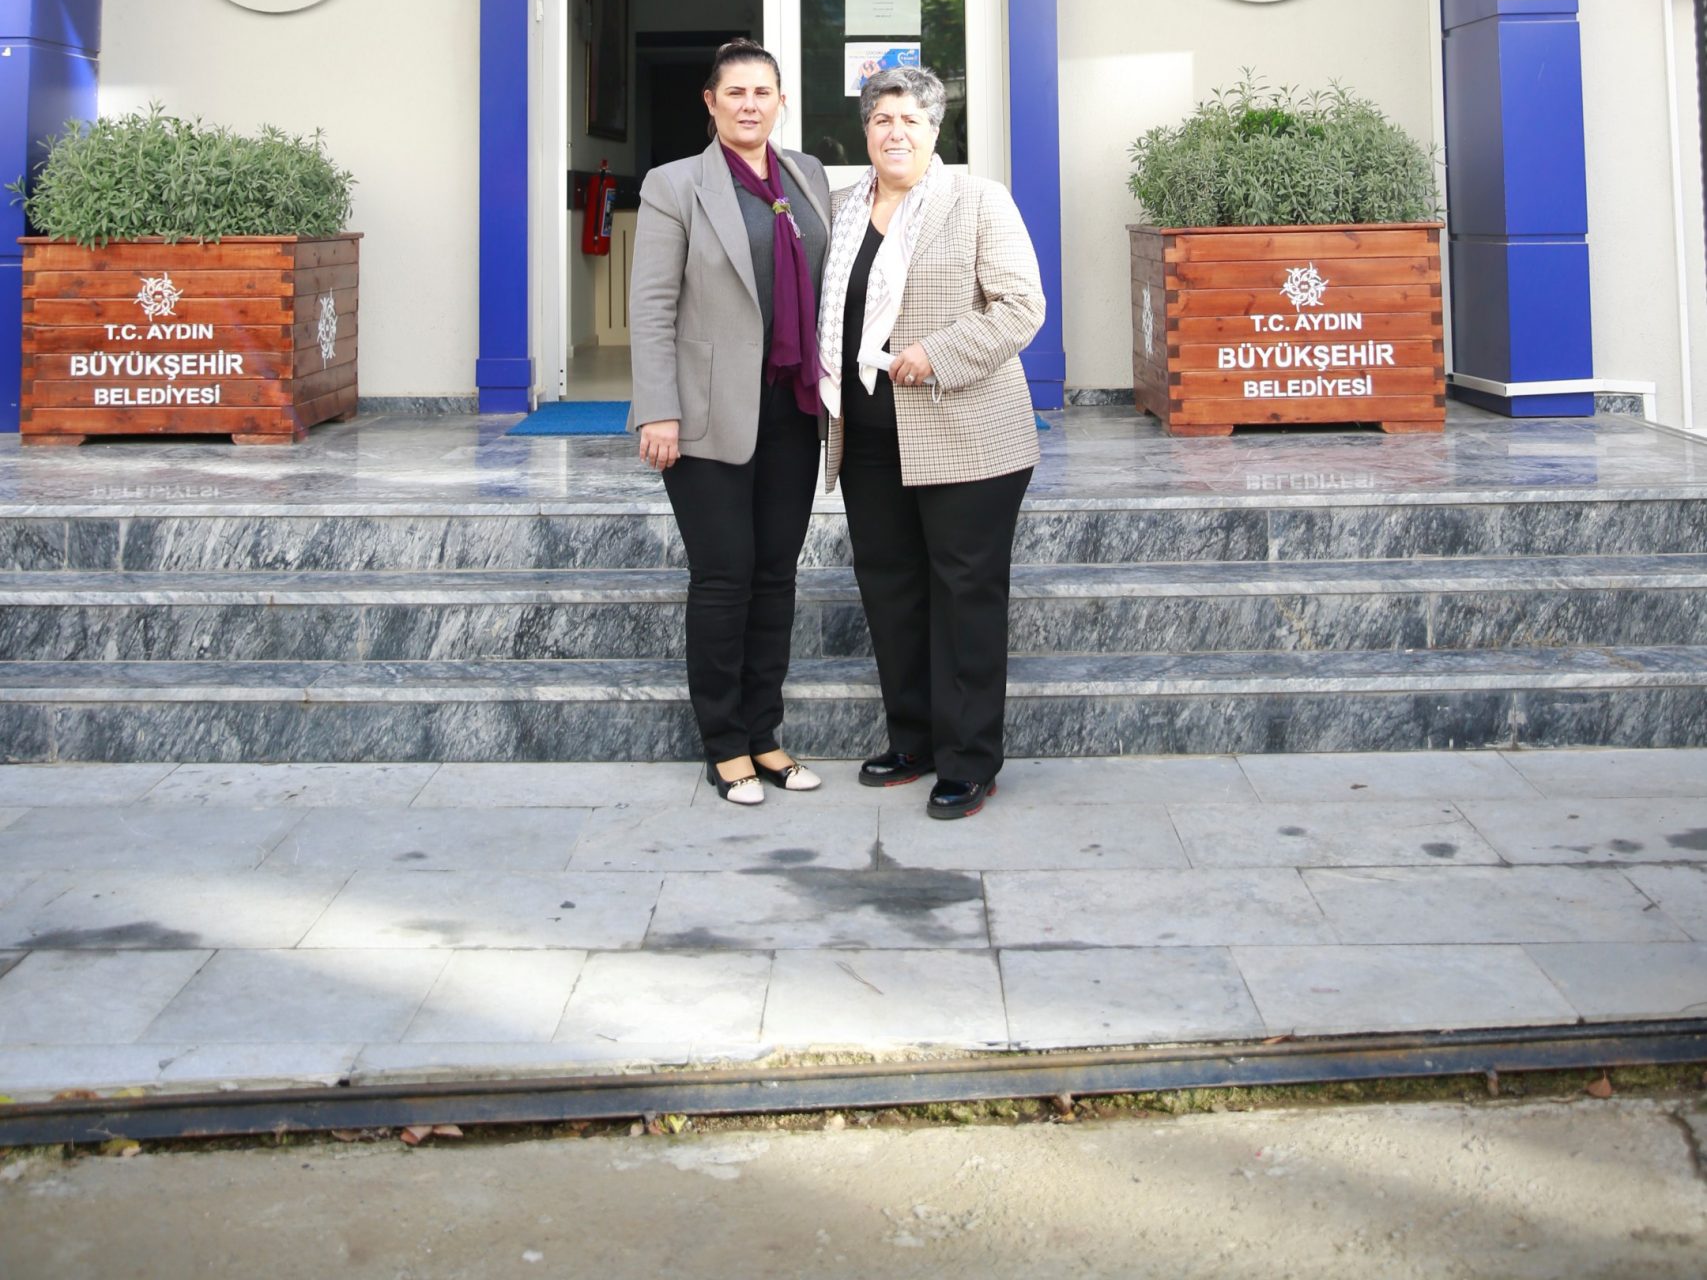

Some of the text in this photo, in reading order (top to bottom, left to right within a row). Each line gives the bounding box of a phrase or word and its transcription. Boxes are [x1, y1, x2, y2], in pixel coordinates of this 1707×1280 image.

[104, 324, 213, 340] T.C. AYDIN
[1250, 313, 1362, 332] T.C. AYDIN
[70, 350, 243, 380] BÜYÜKŞEHİR
[1218, 340, 1395, 371] BÜYÜKŞEHİR
[94, 384, 220, 406] BELEDİYESİ
[1243, 375, 1372, 398] BELEDİYESİ
